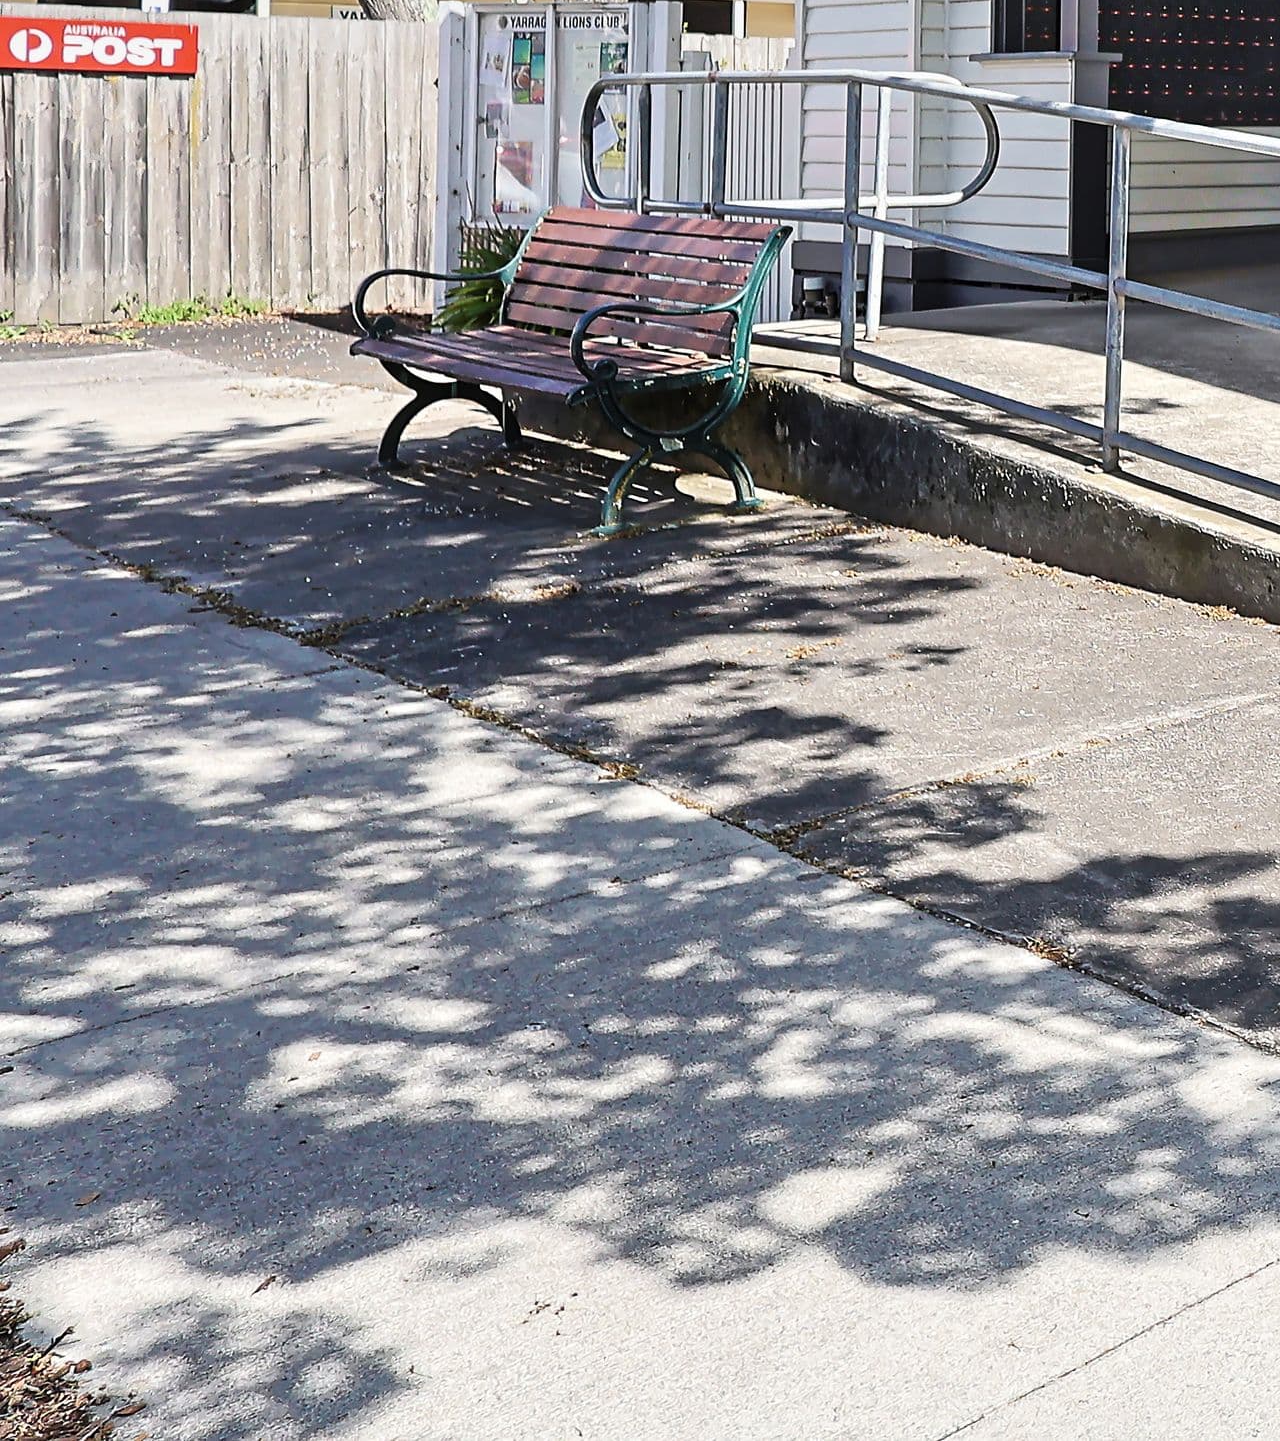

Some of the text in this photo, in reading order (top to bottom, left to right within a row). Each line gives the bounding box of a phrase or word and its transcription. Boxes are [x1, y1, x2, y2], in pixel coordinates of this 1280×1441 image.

[563, 16, 592, 29] LIONS
[594, 16, 619, 29] CLUB
[64, 24, 126, 36] AUSTRALIA
[62, 35, 183, 67] POST
